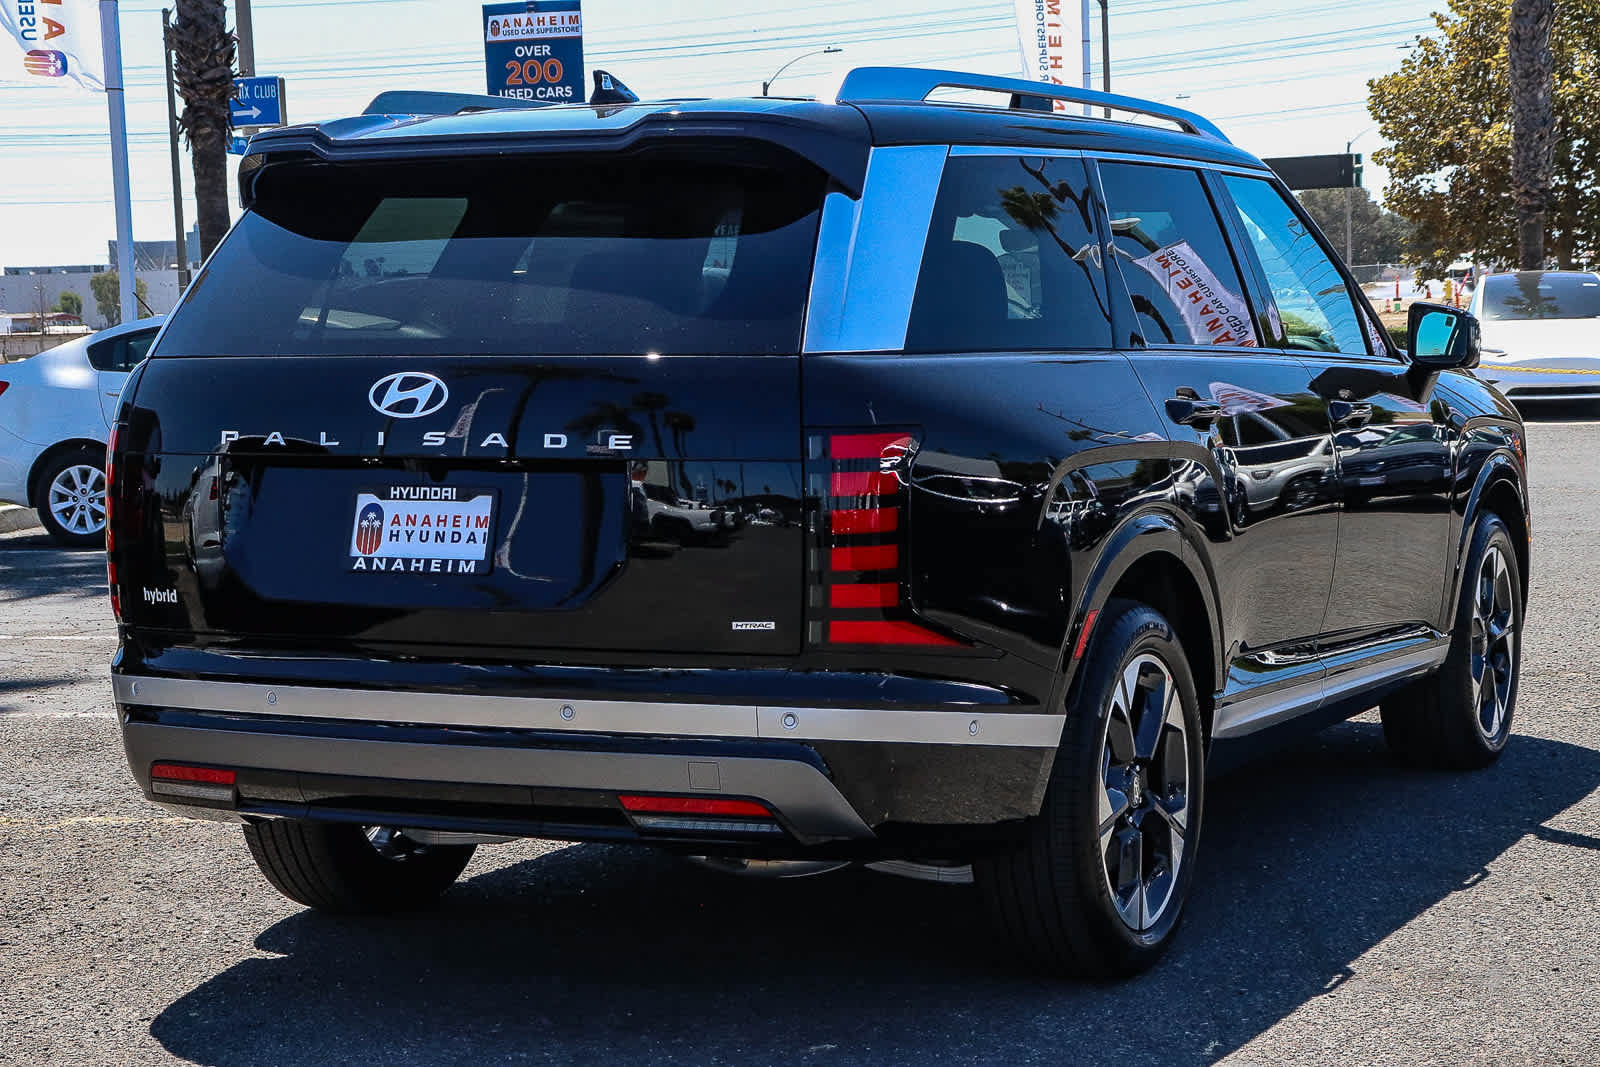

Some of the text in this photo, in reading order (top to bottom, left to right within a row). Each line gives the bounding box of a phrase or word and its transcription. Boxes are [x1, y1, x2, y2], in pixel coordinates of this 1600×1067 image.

[502, 15, 580, 28] ANAHEIM
[502, 28, 520, 36] USED
[536, 26, 580, 34] SUPERSTORE
[515, 45, 551, 57] OVER
[505, 58, 563, 85] 200
[254, 84, 277, 99] CLUB
[499, 86, 572, 99] USED CARS
[1155, 253, 1236, 345] ANAHEIM
[1166, 249, 1248, 339] USED CAR SUPERSTORE
[220, 430, 633, 450] PALISADE
[390, 486, 456, 500] HYUNDAI
[390, 514, 489, 528] ANAHEIM
[388, 529, 487, 545] HYUNDAI
[353, 557, 476, 573] ANAHEIM
[143, 586, 178, 605] hybrid
